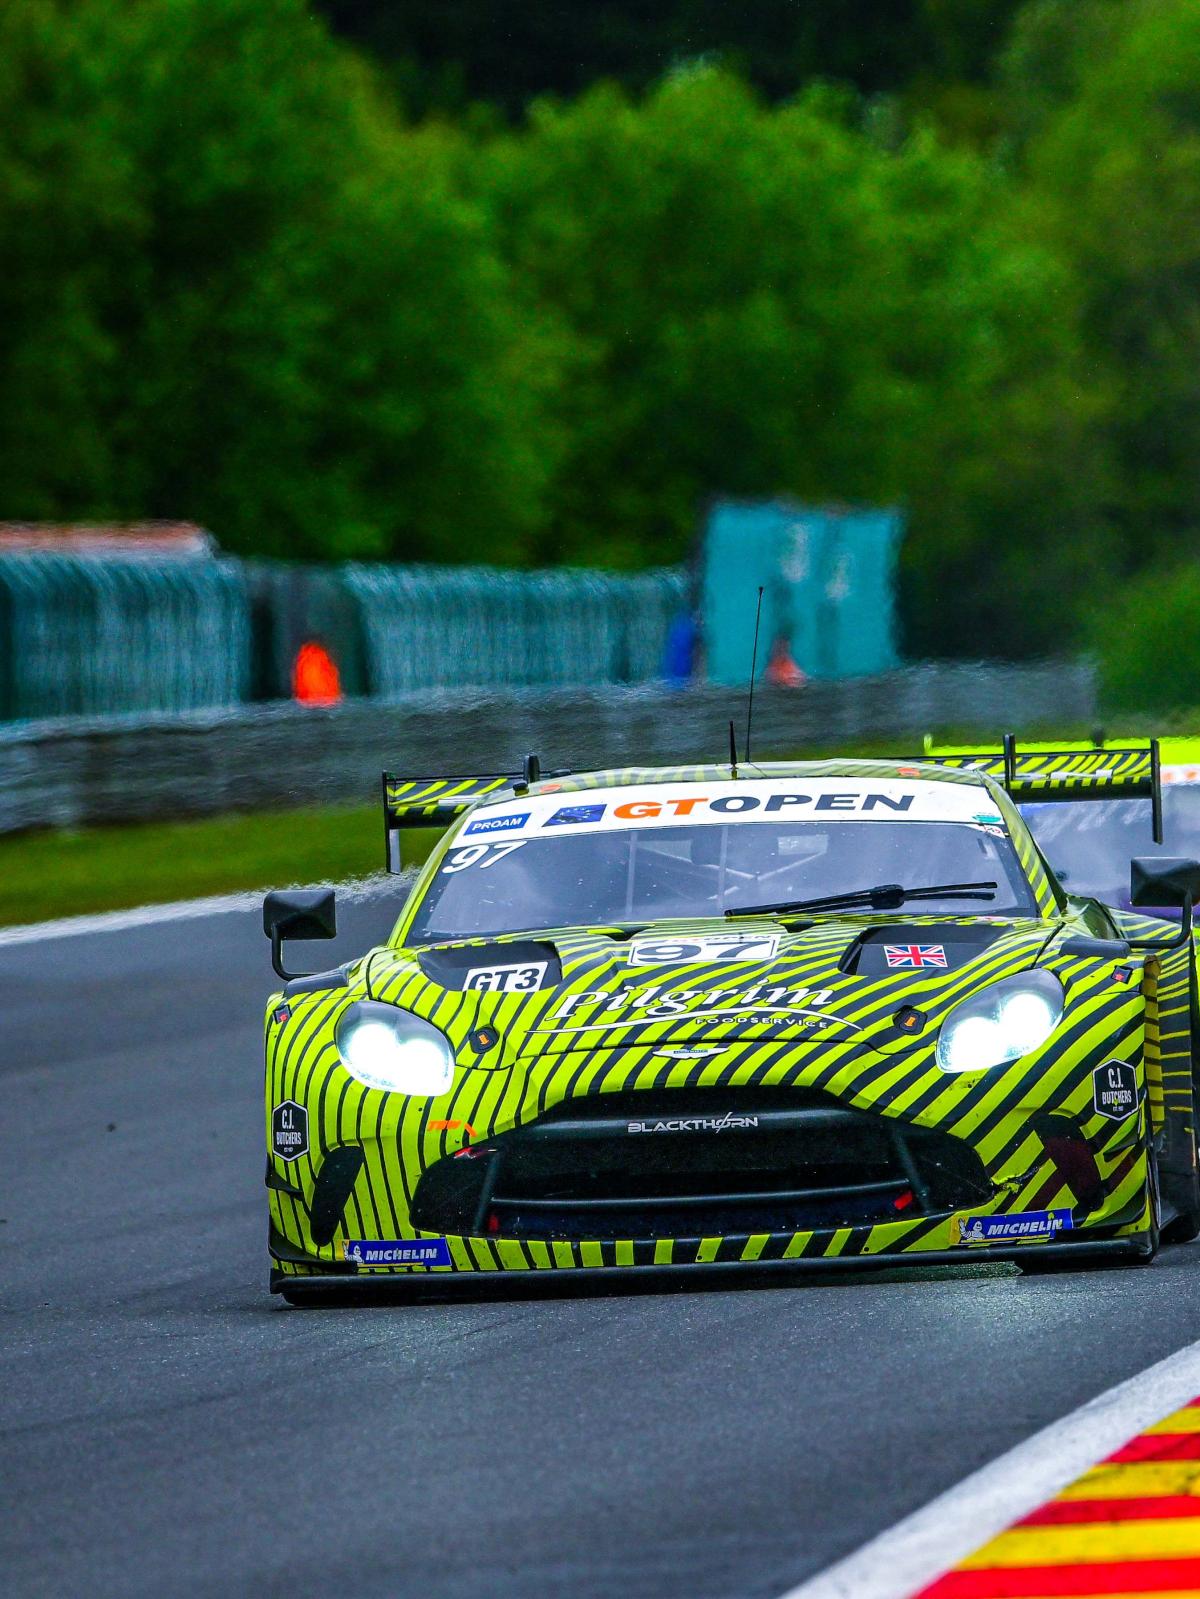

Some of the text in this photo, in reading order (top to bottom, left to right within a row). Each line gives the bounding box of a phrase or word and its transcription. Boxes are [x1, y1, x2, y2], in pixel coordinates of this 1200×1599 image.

[472, 816, 523, 832] PROAM
[442, 840, 528, 874] 97
[636, 941, 771, 962] 97
[467, 968, 541, 992] GT3
[546, 978, 834, 1021] Pilgrim
[696, 1016, 828, 1029] FOODSERVICE
[1108, 1067, 1124, 1089] C.J.
[1101, 1090, 1132, 1105] BUTCHERS
[281, 1109, 295, 1130] C.J.
[276, 1131, 302, 1146] BUTCHERS
[987, 1218, 1063, 1236] MICHELIN
[365, 1247, 438, 1261] MICHELIN
